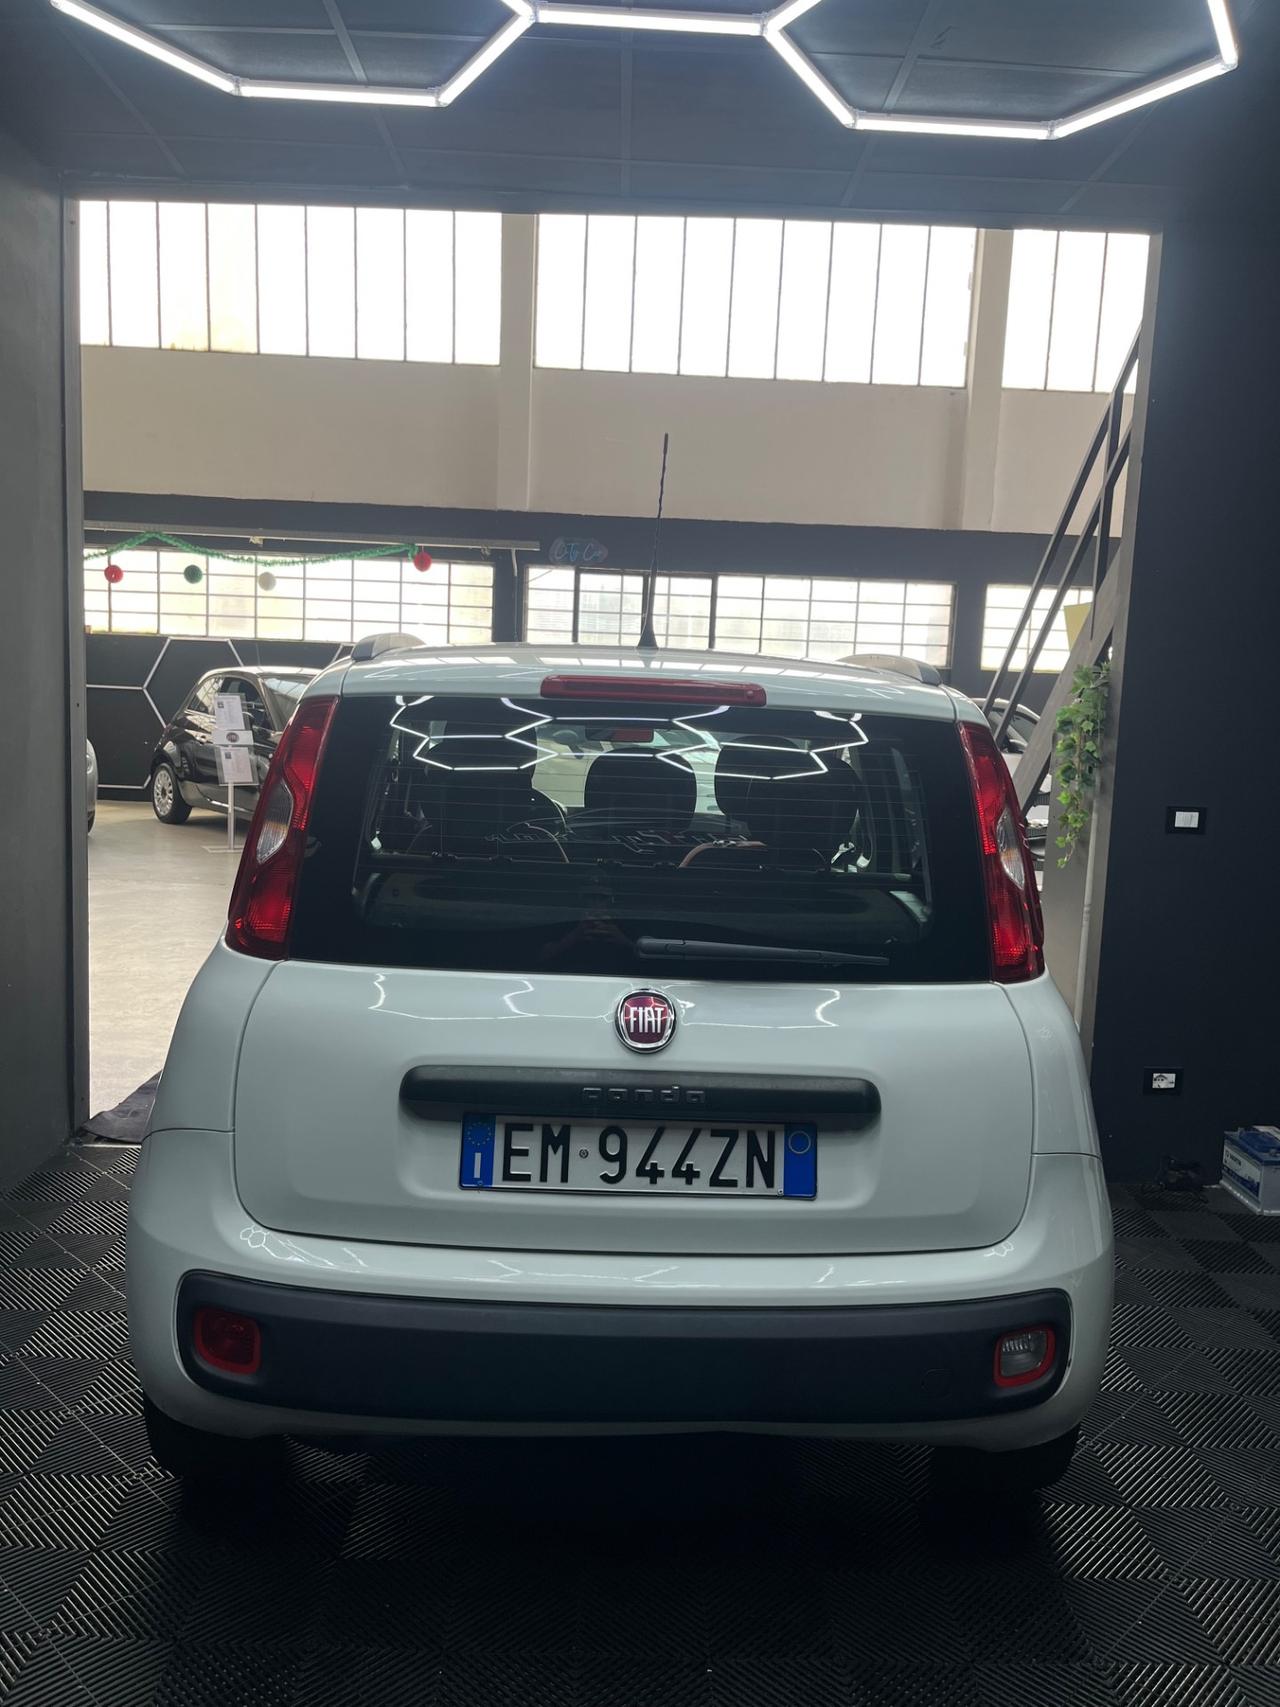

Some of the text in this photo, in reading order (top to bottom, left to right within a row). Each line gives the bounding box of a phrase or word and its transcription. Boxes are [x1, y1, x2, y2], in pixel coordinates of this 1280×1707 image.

[630, 1006, 664, 1033] FIAT
[502, 1123, 776, 1189] EM 944ZN
